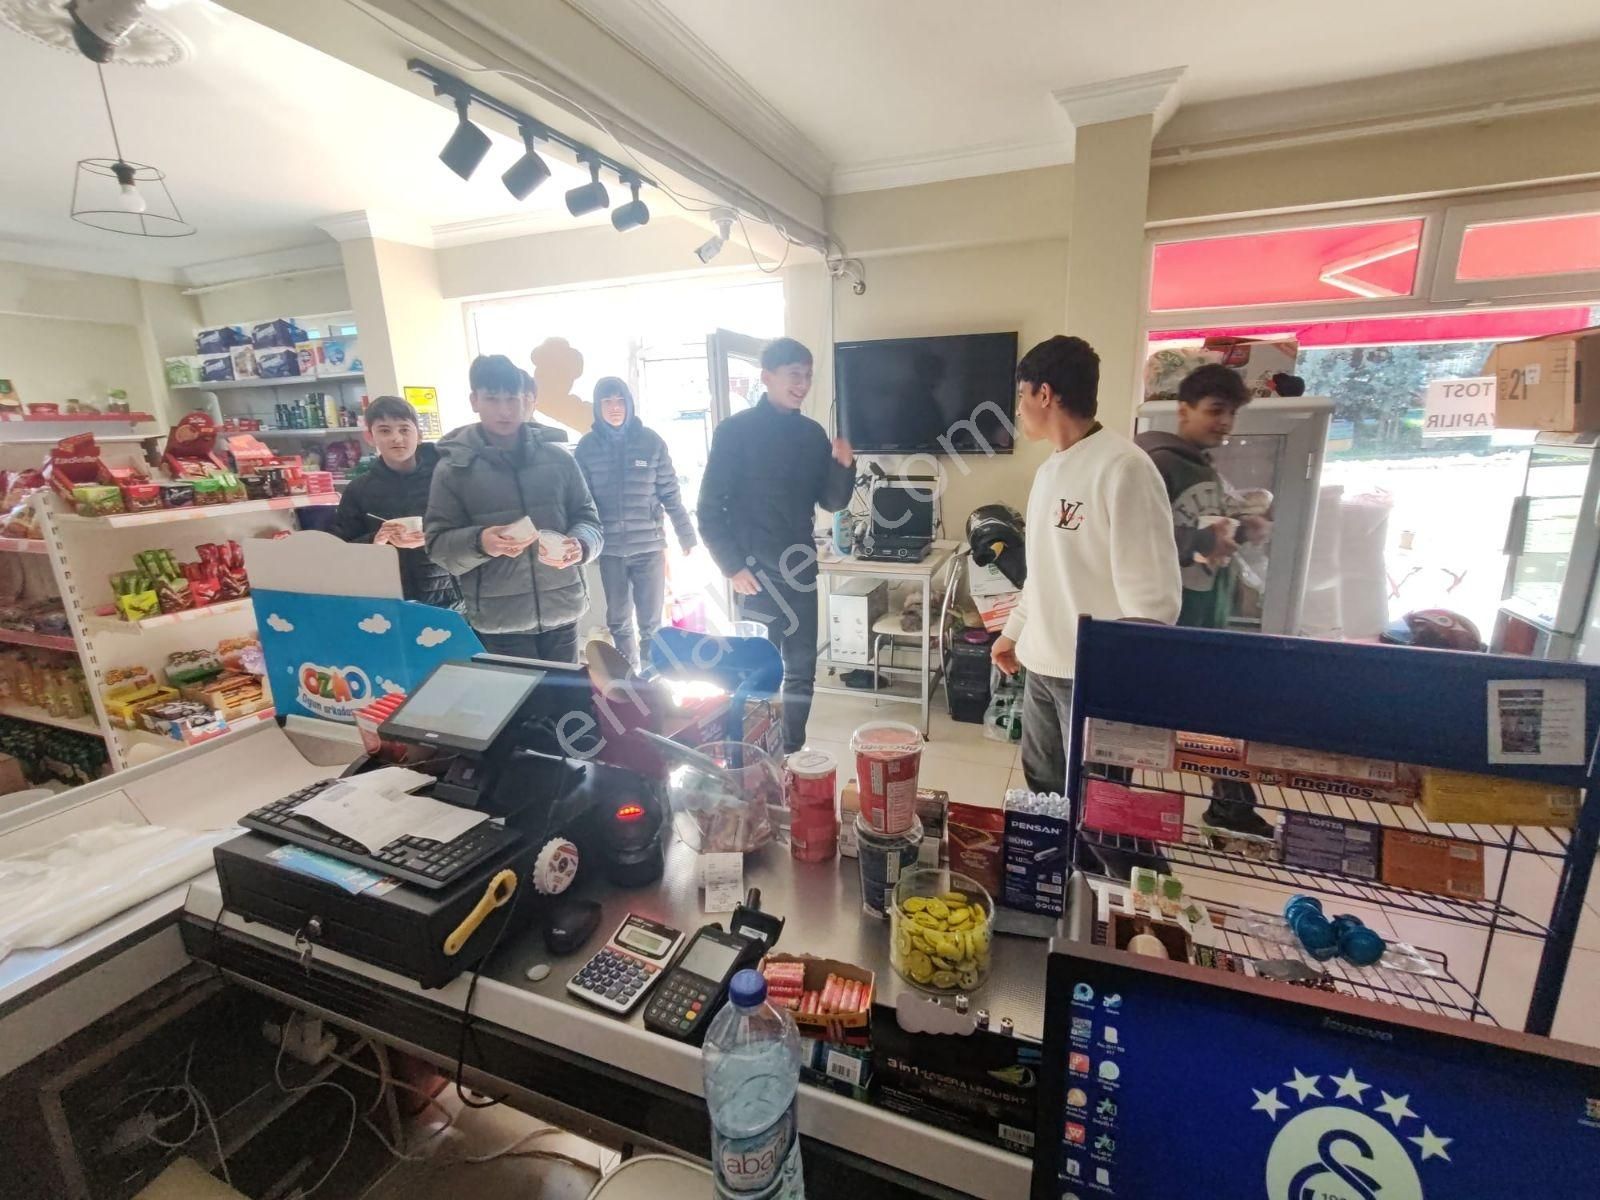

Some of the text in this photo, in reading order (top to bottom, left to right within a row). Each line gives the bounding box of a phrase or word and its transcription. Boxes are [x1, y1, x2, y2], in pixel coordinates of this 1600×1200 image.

[1180, 759, 1250, 779] mentos
[1291, 775, 1374, 799] mentos
[1011, 821, 1060, 835] PENSAN
